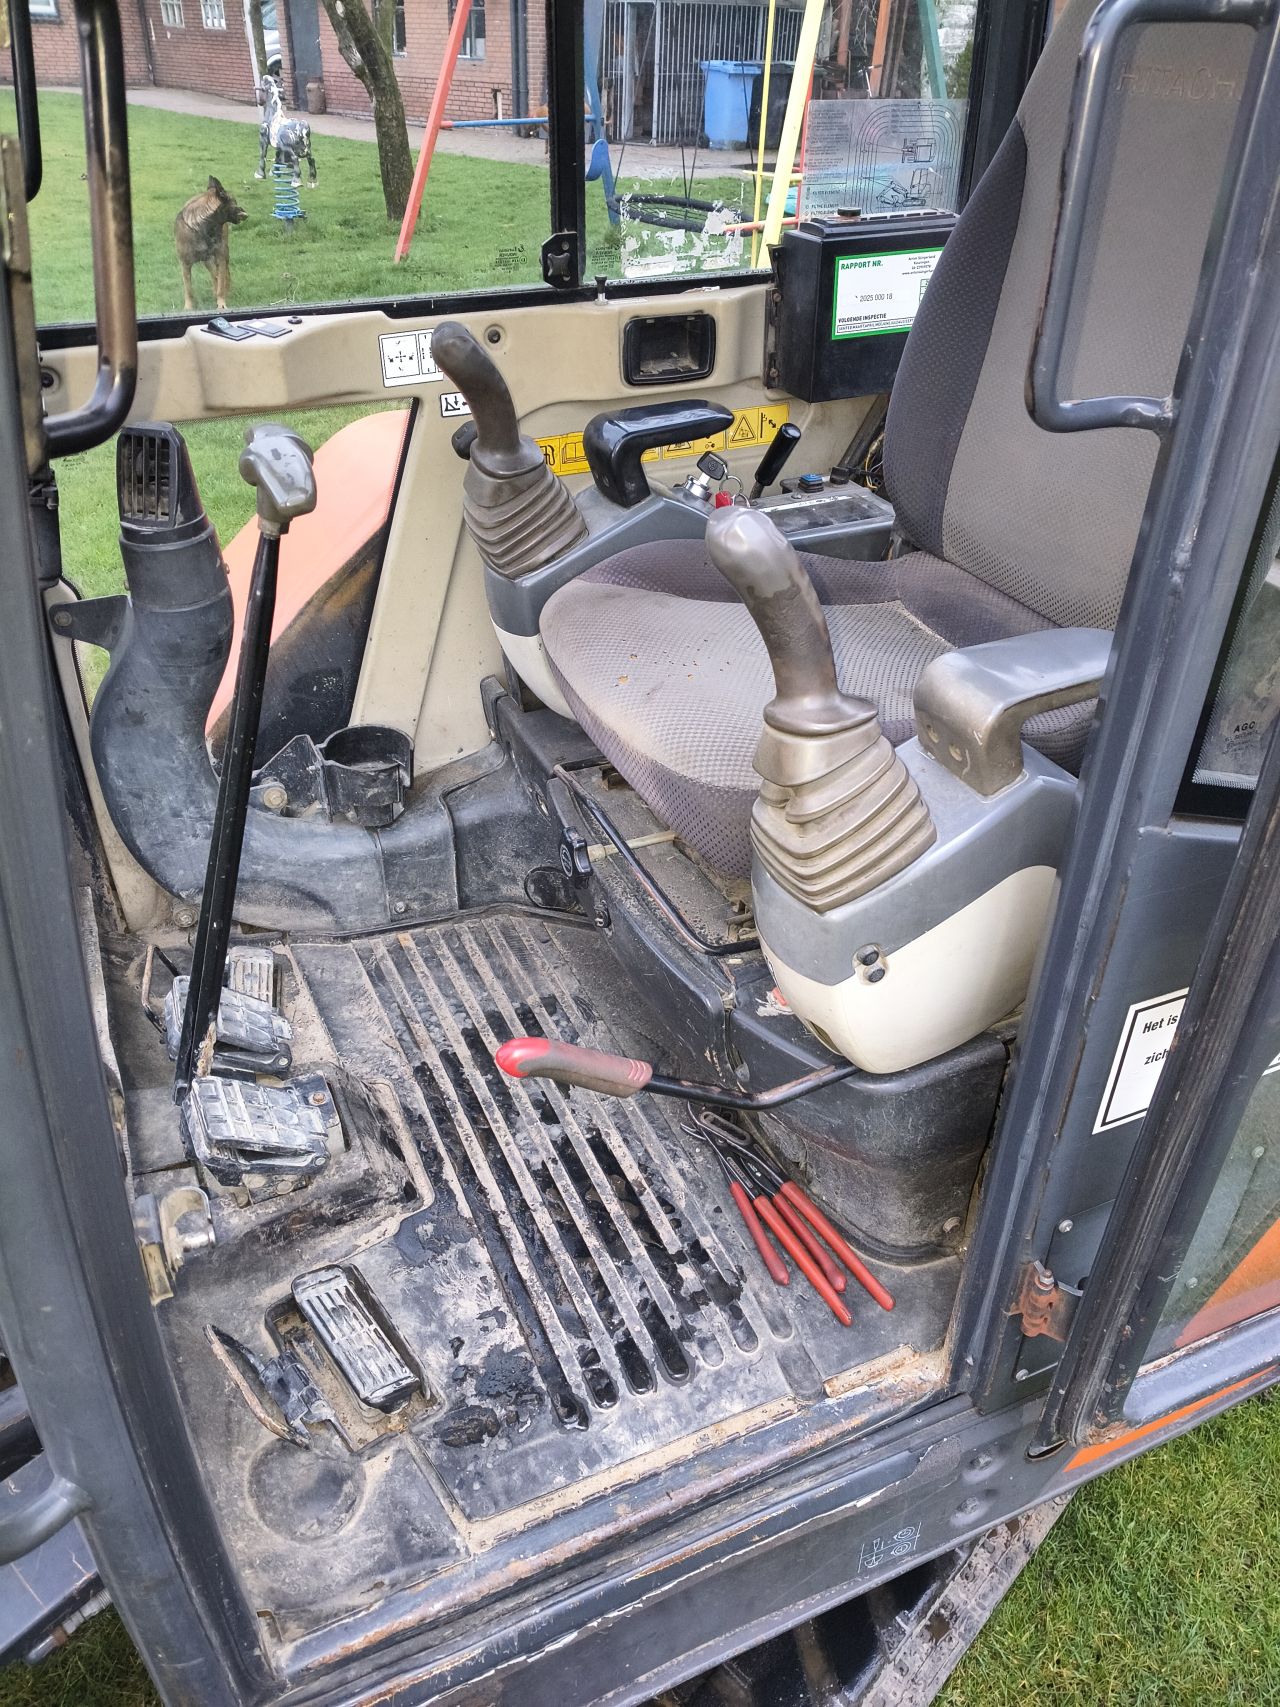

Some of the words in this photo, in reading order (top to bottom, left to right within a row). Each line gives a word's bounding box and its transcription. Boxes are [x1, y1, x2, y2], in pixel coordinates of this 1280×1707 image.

[841, 261, 871, 270] RAPPORT
[872, 259, 884, 267] NR.
[860, 295, 874, 303] 2025
[862, 313, 887, 321] INSPECTIE
[1233, 721, 1256, 734] AGC
[1142, 1017, 1165, 1034] Het
[1166, 1013, 1179, 1027] is
